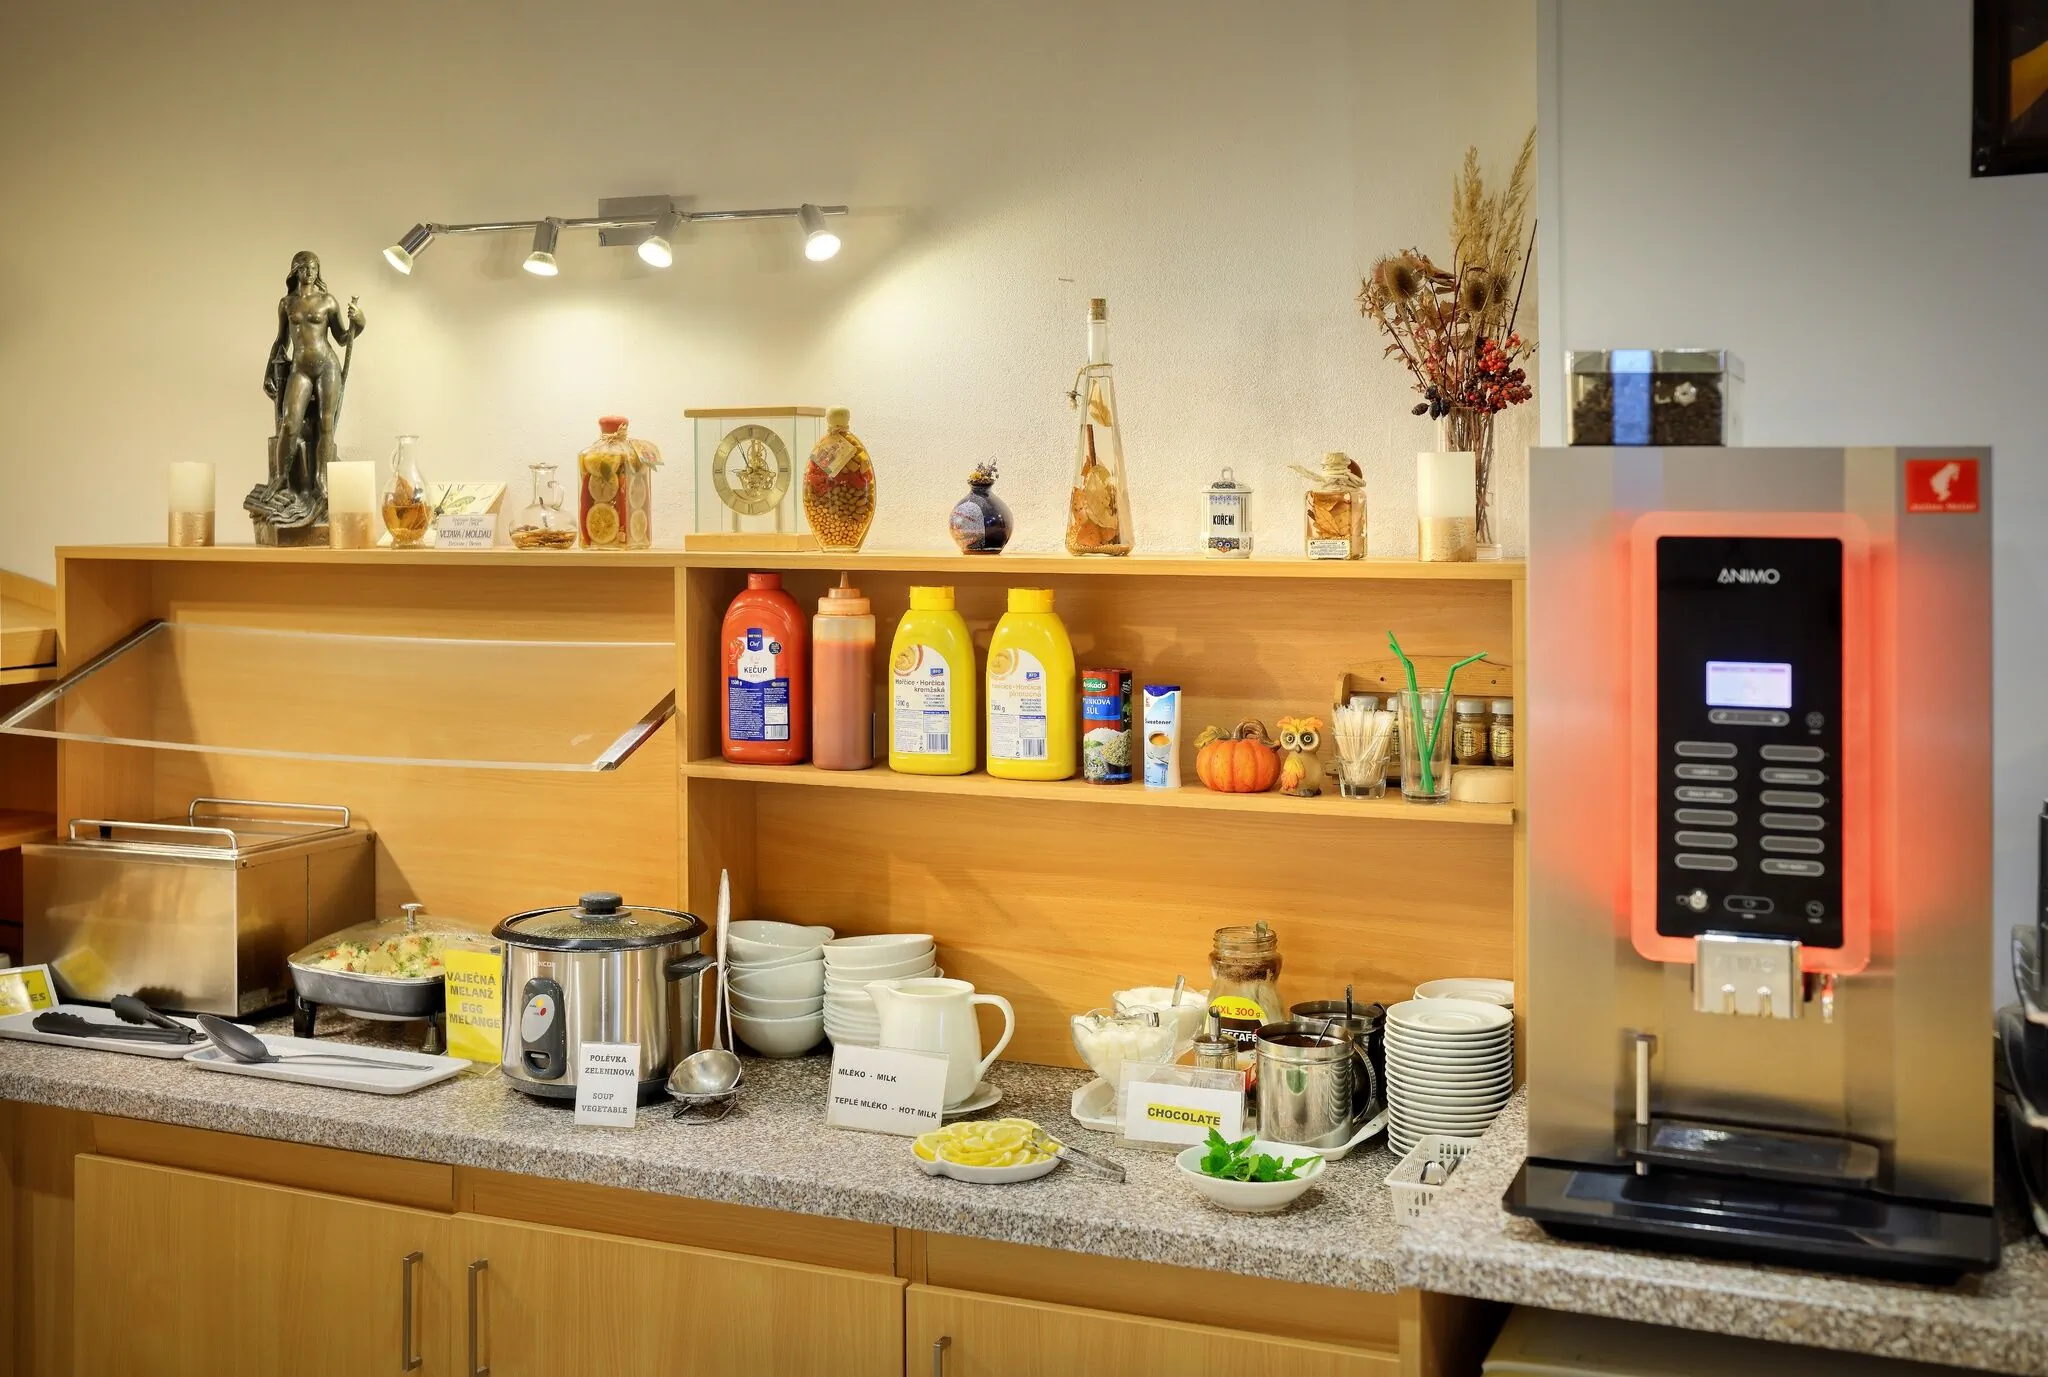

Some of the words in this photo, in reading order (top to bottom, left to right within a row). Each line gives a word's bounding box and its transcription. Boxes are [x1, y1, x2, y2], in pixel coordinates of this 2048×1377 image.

[1212, 512, 1235, 526] KOŘENÍ
[1716, 567, 1781, 585] ANIMO
[743, 664, 768, 674] KEČUP
[1086, 705, 1100, 715] SŮL
[446, 970, 497, 986] VAJEČNÁ
[450, 985, 494, 1000] MELANŽ
[461, 1001, 484, 1015] EGG
[1235, 1007, 1255, 1017] 300
[448, 1012, 501, 1029] MELANGE
[590, 1053, 627, 1063] POLÉVKA
[584, 1066, 635, 1077] ZELENINOVÁ
[838, 1067, 866, 1079] MLÉKO
[876, 1072, 897, 1083] MILK
[592, 1092, 615, 1101] SOUP
[581, 1104, 628, 1114] VEGETABLE
[834, 1096, 859, 1106] TEPLÉ
[860, 1099, 888, 1111] MLÉKO
[898, 1106, 916, 1115] HOT
[917, 1109, 937, 1120] MILK
[1147, 1107, 1221, 1127] CHOCOLATE
